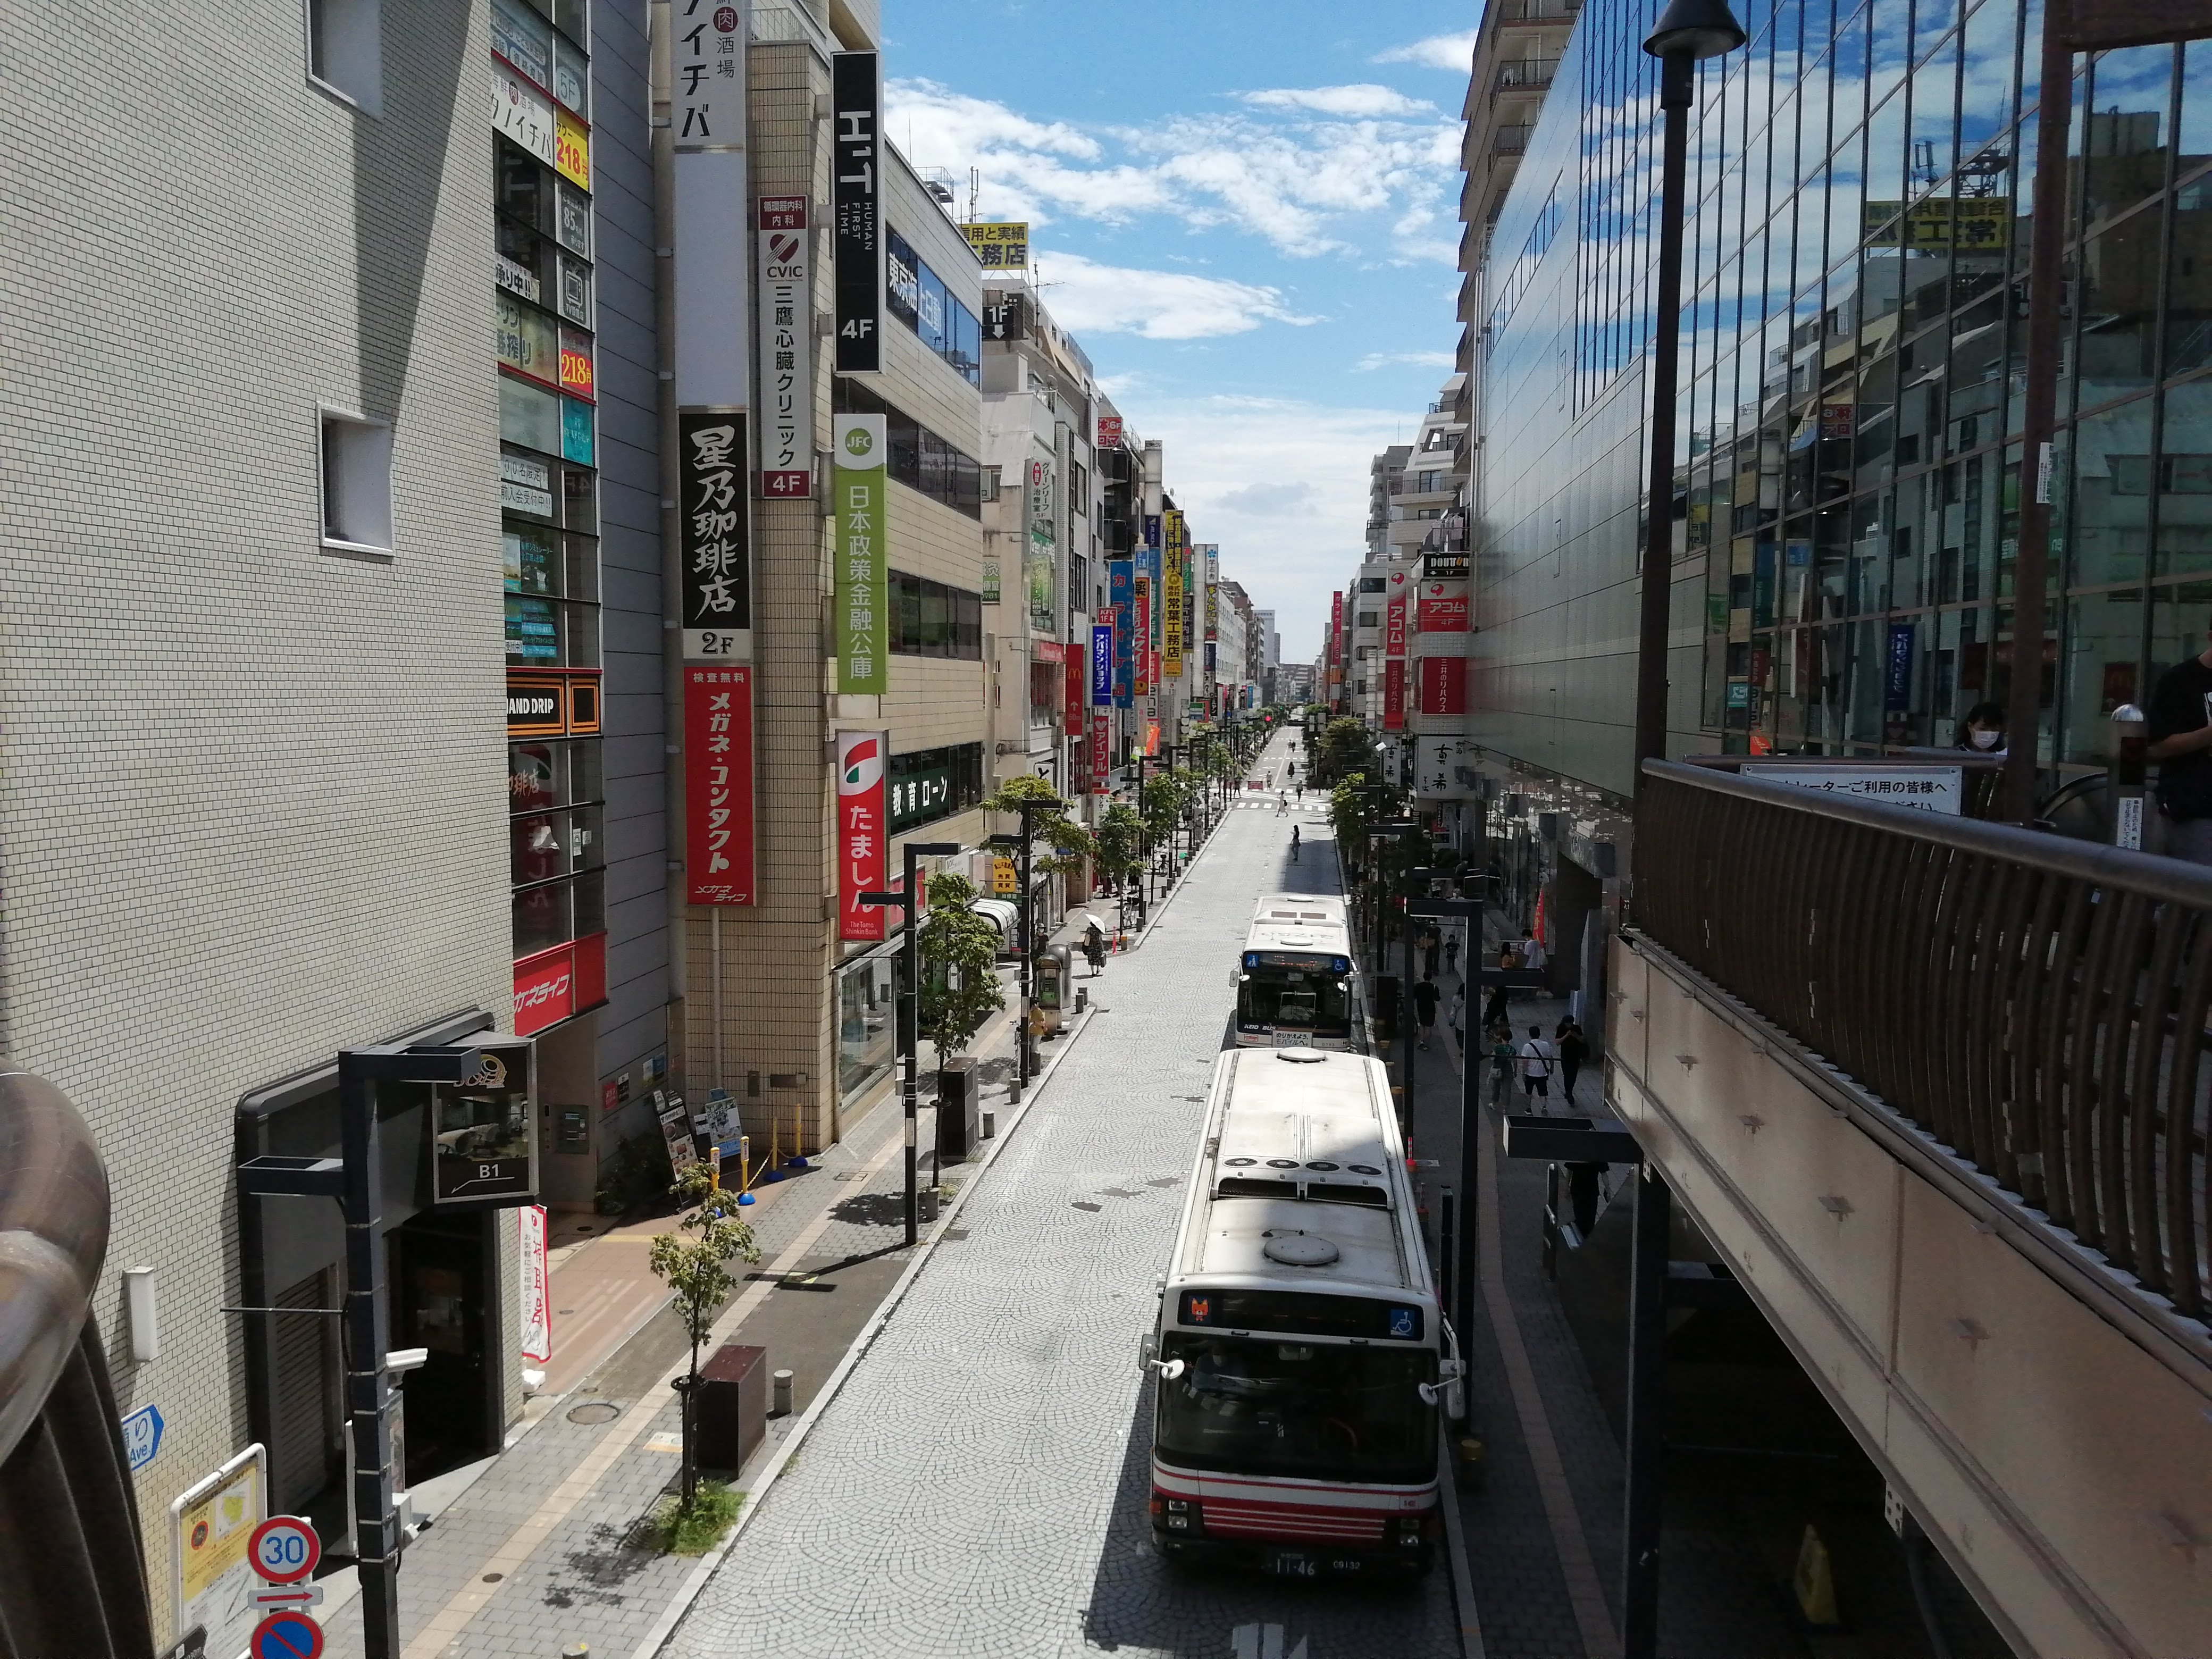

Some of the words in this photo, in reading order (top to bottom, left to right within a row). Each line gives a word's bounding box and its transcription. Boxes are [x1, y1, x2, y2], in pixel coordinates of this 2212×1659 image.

[715, 0, 736, 78] 肉酒場
[560, 72, 576, 103] 5F
[763, 200, 803, 213] 循環器内科
[772, 215, 795, 227] 内科
[852, 202, 861, 239] FIRST
[864, 202, 873, 250] HUMAN
[767, 265, 803, 278] CVIC
[889, 252, 941, 336] 東京海上日動
[988, 305, 1008, 323] 1F
[841, 319, 874, 339] 4F
[774, 286, 795, 467] 三鷹心臓クリニック
[847, 436, 871, 449] JFC
[772, 475, 801, 492] 4F
[690, 424, 739, 622] 星乃珈琲店
[983, 562, 1000, 577] 灸
[849, 486, 873, 680] 日本政策金融公庫
[1135, 580, 1146, 597] 薬
[1429, 601, 1466, 613] アコム
[1167, 598, 1180, 658] 常葉工務店
[1390, 606, 1404, 644] アコム
[701, 632, 735, 655] 2F
[1095, 634, 1104, 690] アパマンショップ
[693, 672, 745, 683] 検査無料
[531, 698, 554, 714] DRIP
[1096, 731, 1107, 772] アイフル
[708, 692, 731, 874] メガネ・コンタクト
[893, 776, 948, 817] 教育ローン
[695, 884, 733, 894] メガネ
[713, 893, 747, 902] ライフ
[478, 1164, 500, 1178] B1
[265, 1536, 304, 1564] 30
